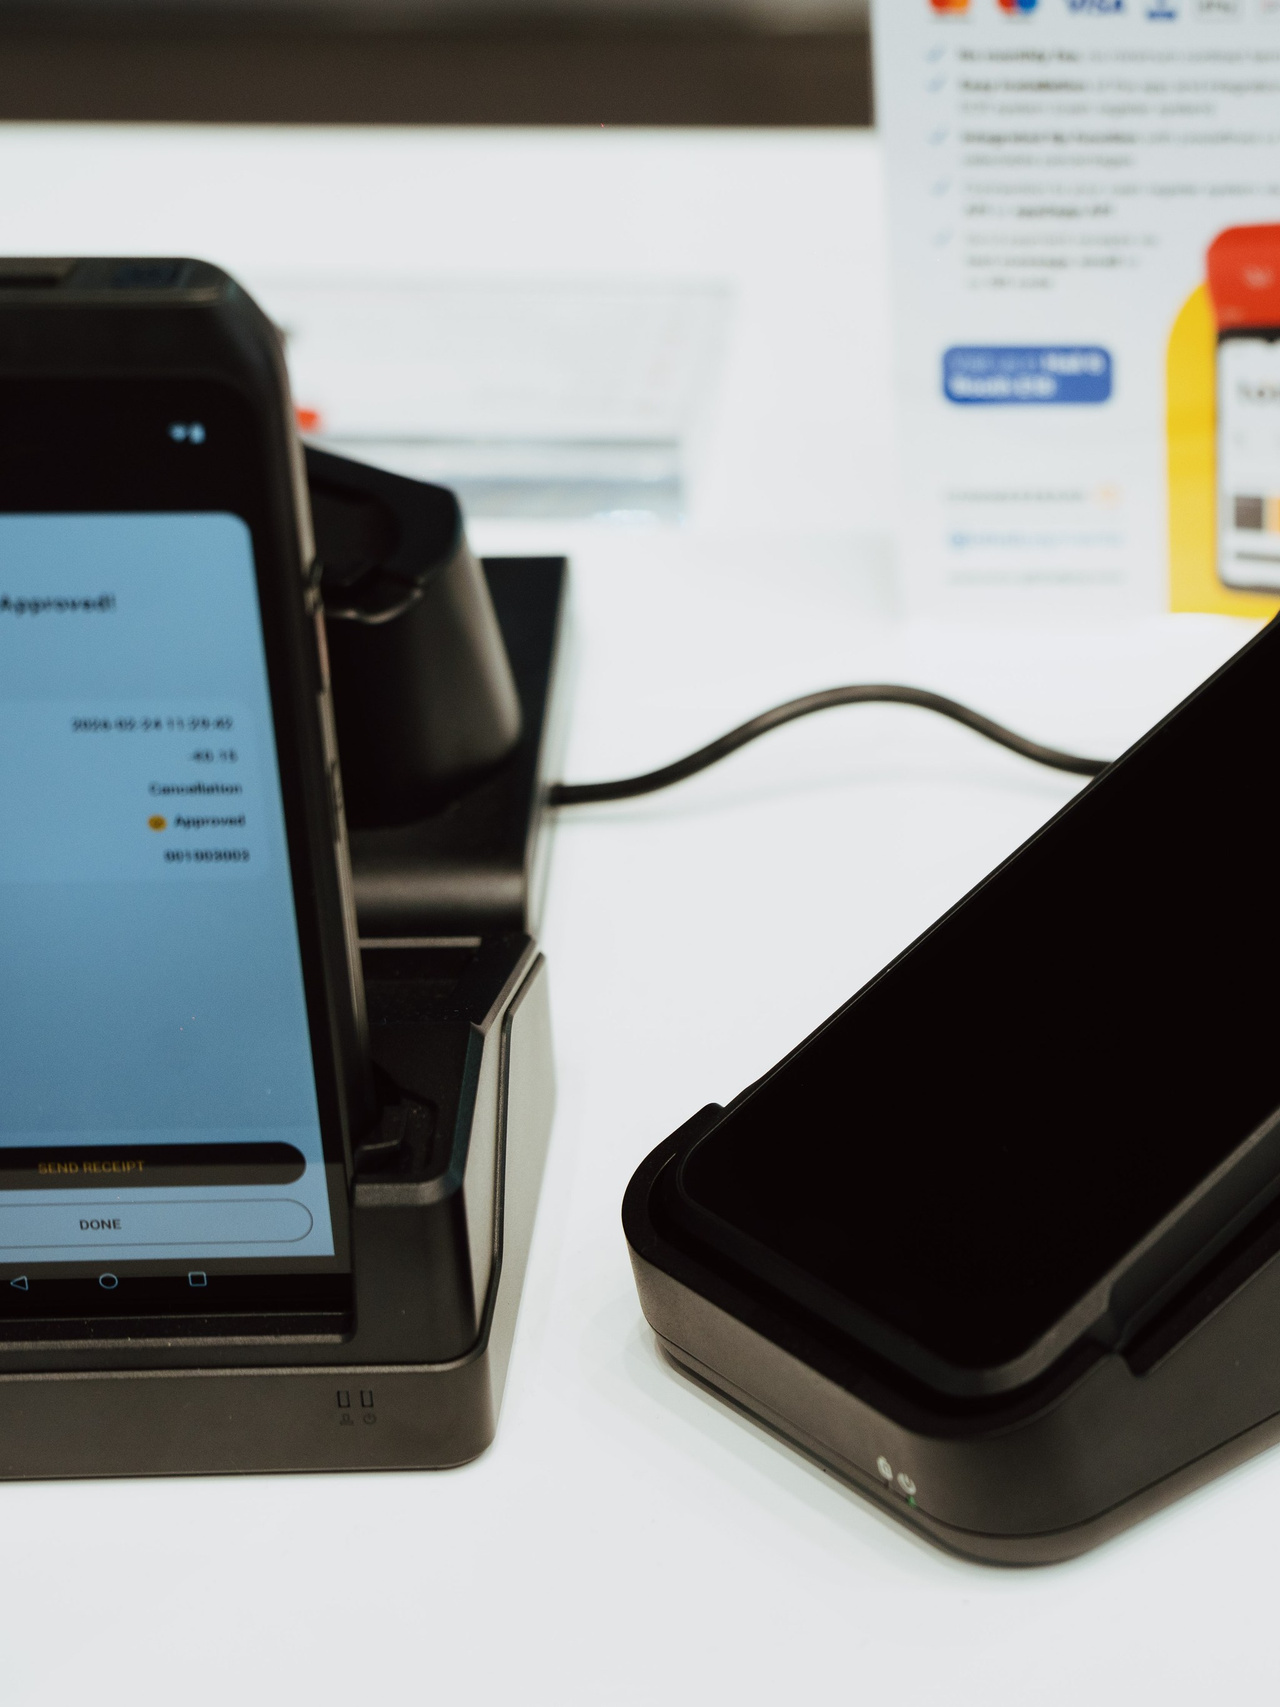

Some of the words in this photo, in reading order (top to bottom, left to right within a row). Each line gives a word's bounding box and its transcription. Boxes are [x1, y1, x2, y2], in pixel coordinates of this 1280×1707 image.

[149, 782, 242, 796] Cancellation
[174, 813, 246, 828] Approved
[38, 1161, 79, 1175] SEND
[83, 1160, 145, 1173] RECEIPT
[79, 1218, 122, 1231] DONE
